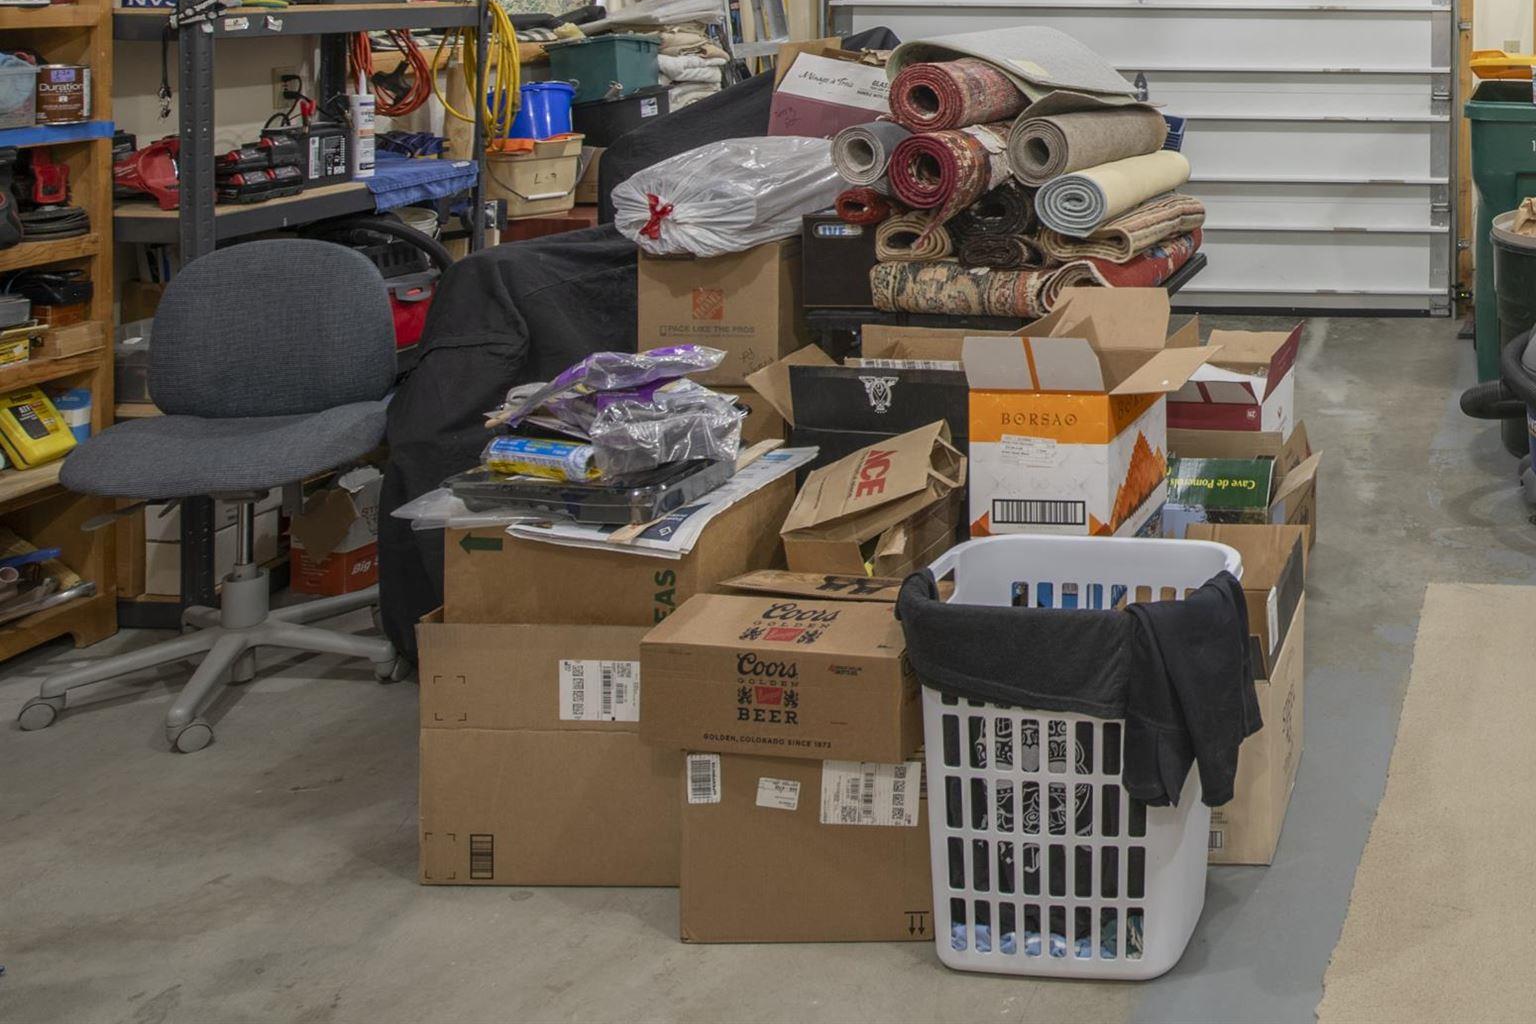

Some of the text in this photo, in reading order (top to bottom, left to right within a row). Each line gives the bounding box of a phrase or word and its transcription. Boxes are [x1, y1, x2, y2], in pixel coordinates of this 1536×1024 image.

[40, 83, 84, 92] Duration
[1001, 412, 1078, 426] BORSAO
[854, 449, 898, 498] ACE
[1217, 479, 1229, 490] de
[1231, 480, 1256, 490] Cave
[762, 603, 842, 621] Coors
[737, 652, 799, 678] Coors
[738, 678, 799, 687] GOLDEN
[737, 707, 799, 724] BEER
[703, 734, 738, 743] GOLDEN,
[740, 736, 785, 746] COLORADO
[787, 739, 812, 748] SINCE
